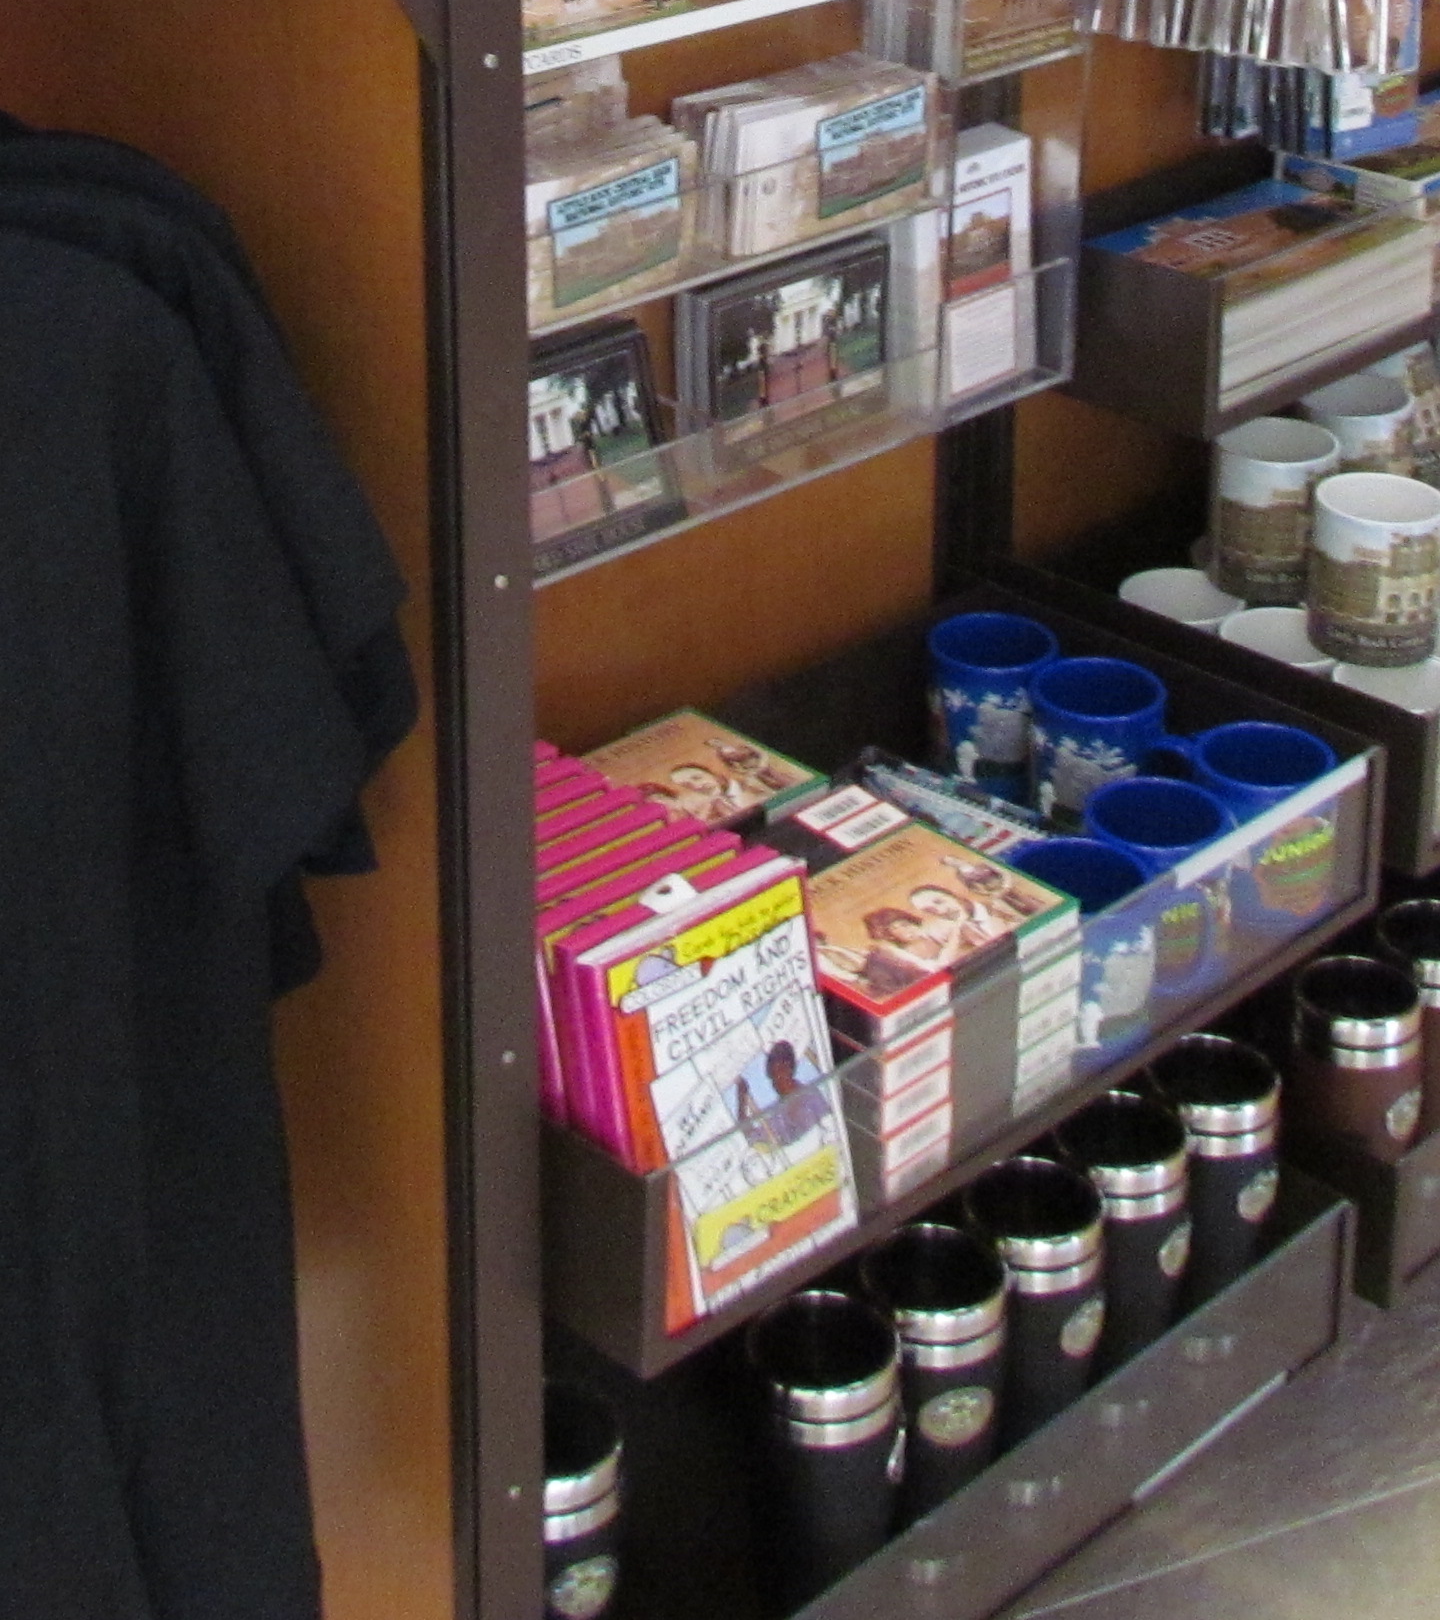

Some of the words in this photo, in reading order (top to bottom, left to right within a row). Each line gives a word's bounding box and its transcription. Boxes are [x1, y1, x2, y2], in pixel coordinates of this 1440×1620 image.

[655, 969, 749, 1041] FREEDOM
[754, 935, 792, 971] AND
[668, 1006, 731, 1062] CIVIL
[740, 949, 808, 1011] RIGHTS
